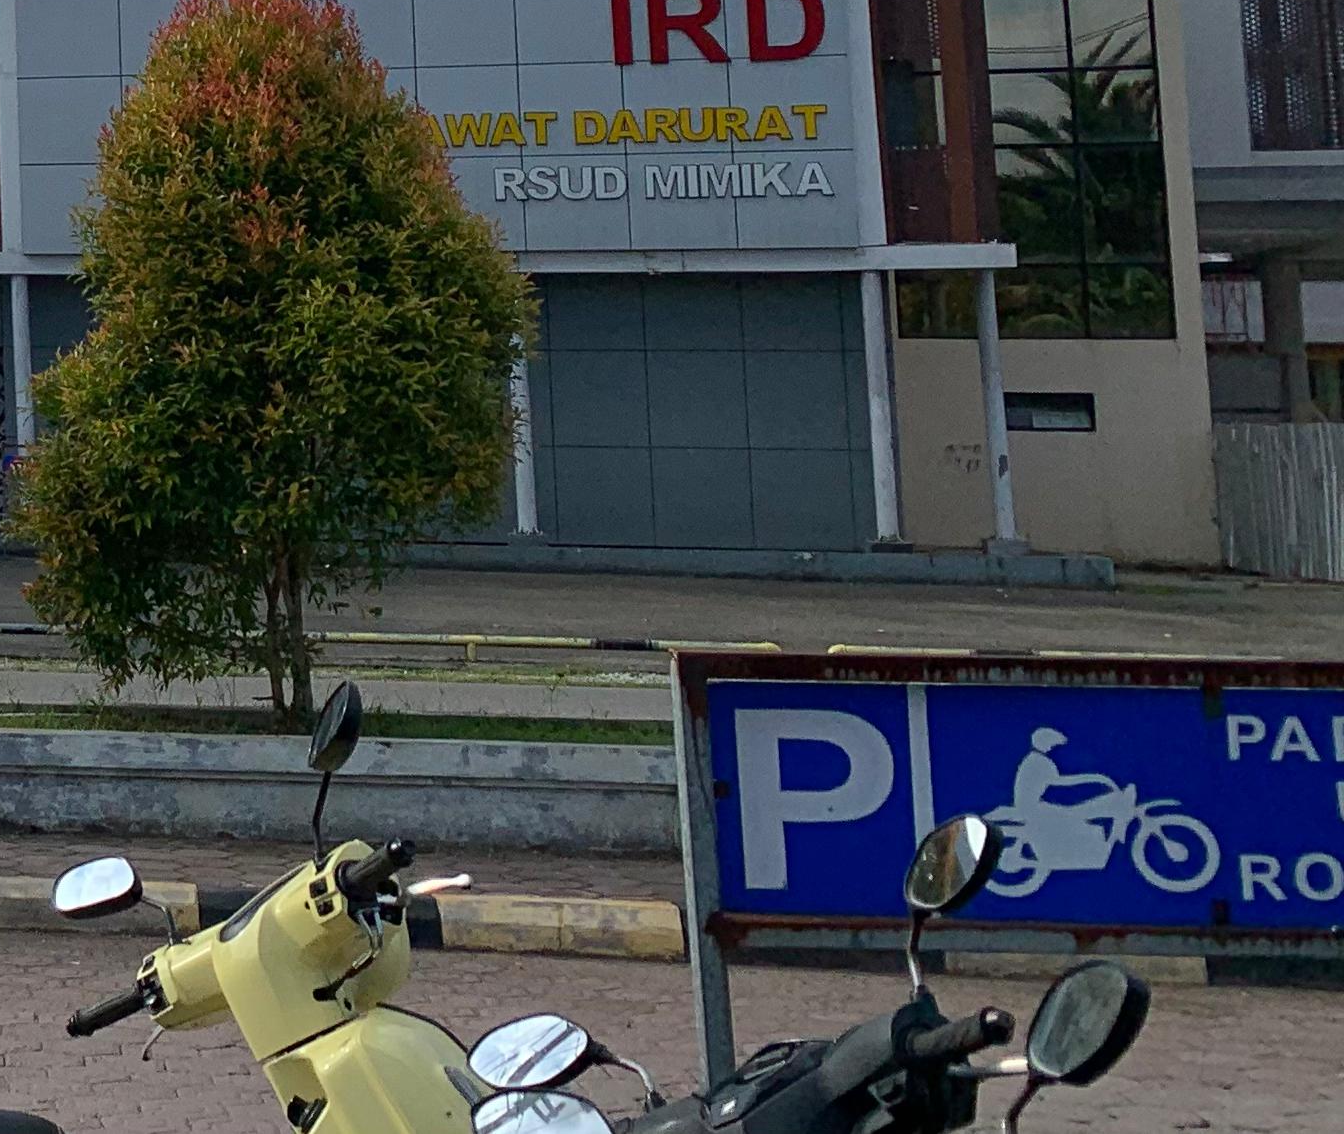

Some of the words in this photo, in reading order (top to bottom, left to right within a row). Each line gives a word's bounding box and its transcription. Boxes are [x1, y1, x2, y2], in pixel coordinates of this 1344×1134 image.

[574, 104, 827, 146] DARURAT
[494, 165, 628, 202] RSUD
[645, 161, 834, 200] MIMIKA
[734, 708, 895, 890] P
